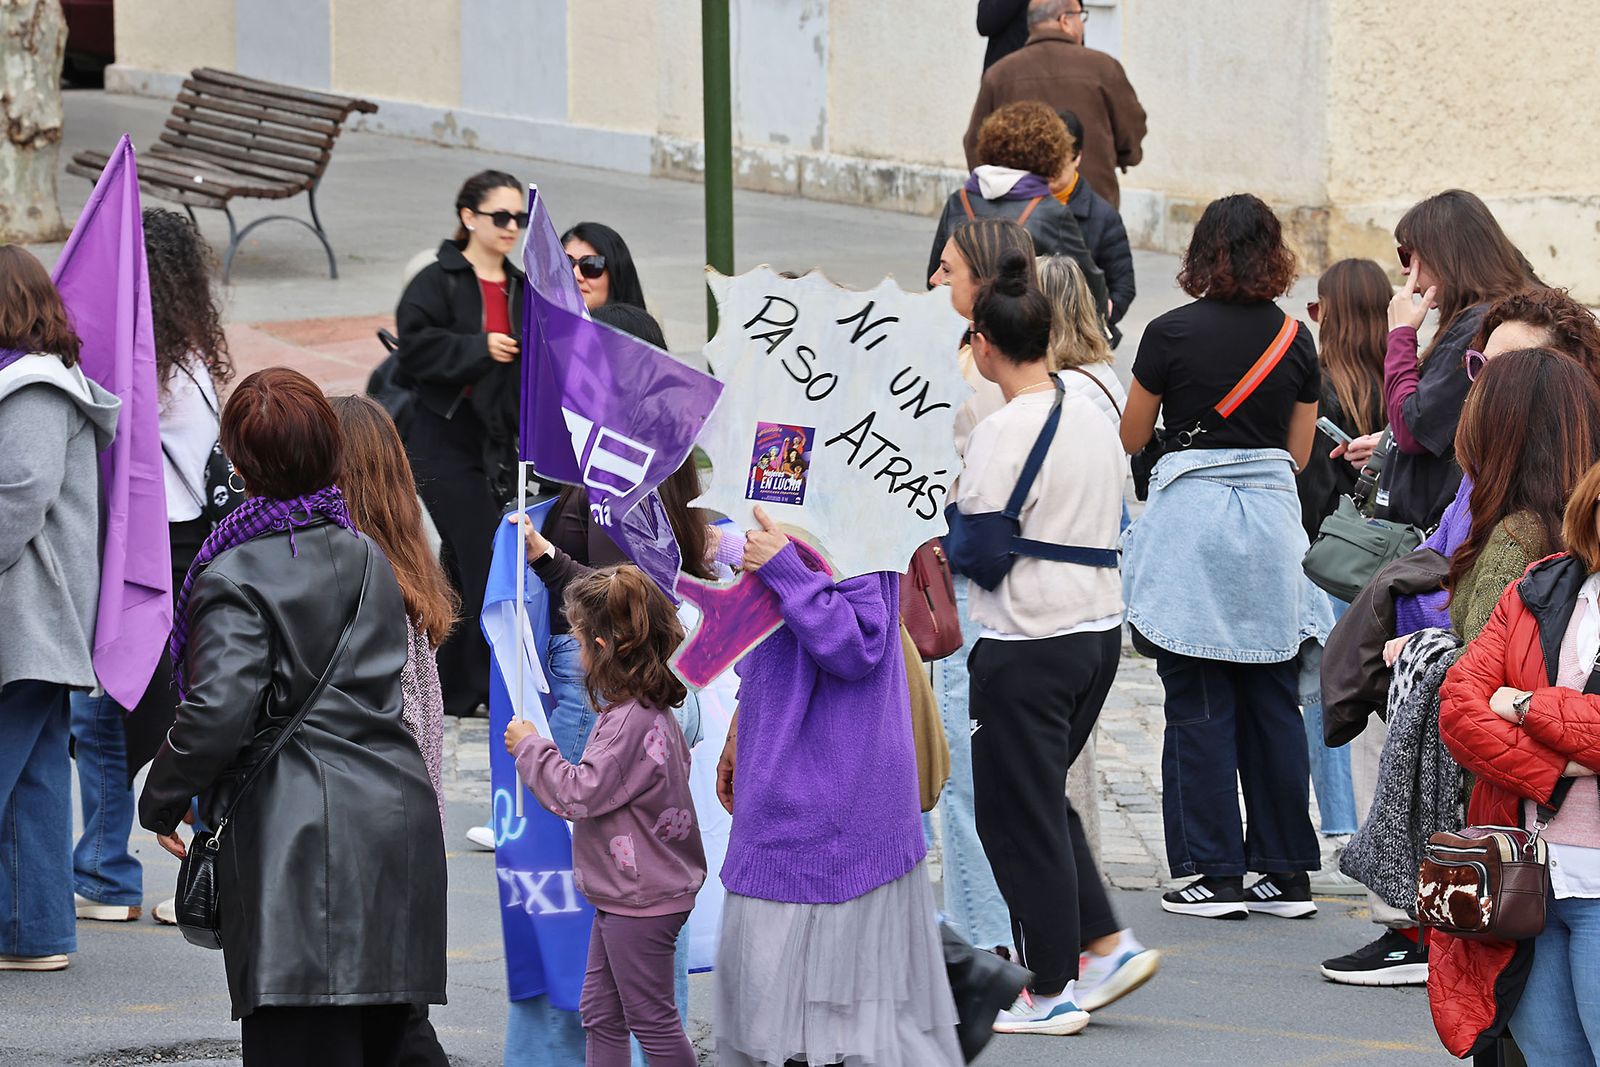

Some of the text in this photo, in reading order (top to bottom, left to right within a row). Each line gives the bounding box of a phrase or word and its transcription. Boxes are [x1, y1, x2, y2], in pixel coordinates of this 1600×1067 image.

[743, 295, 947, 520] PASO ATRÁS
[889, 366, 951, 419] UN
[760, 477, 773, 490] EN
[773, 477, 803, 492] LUCHA
